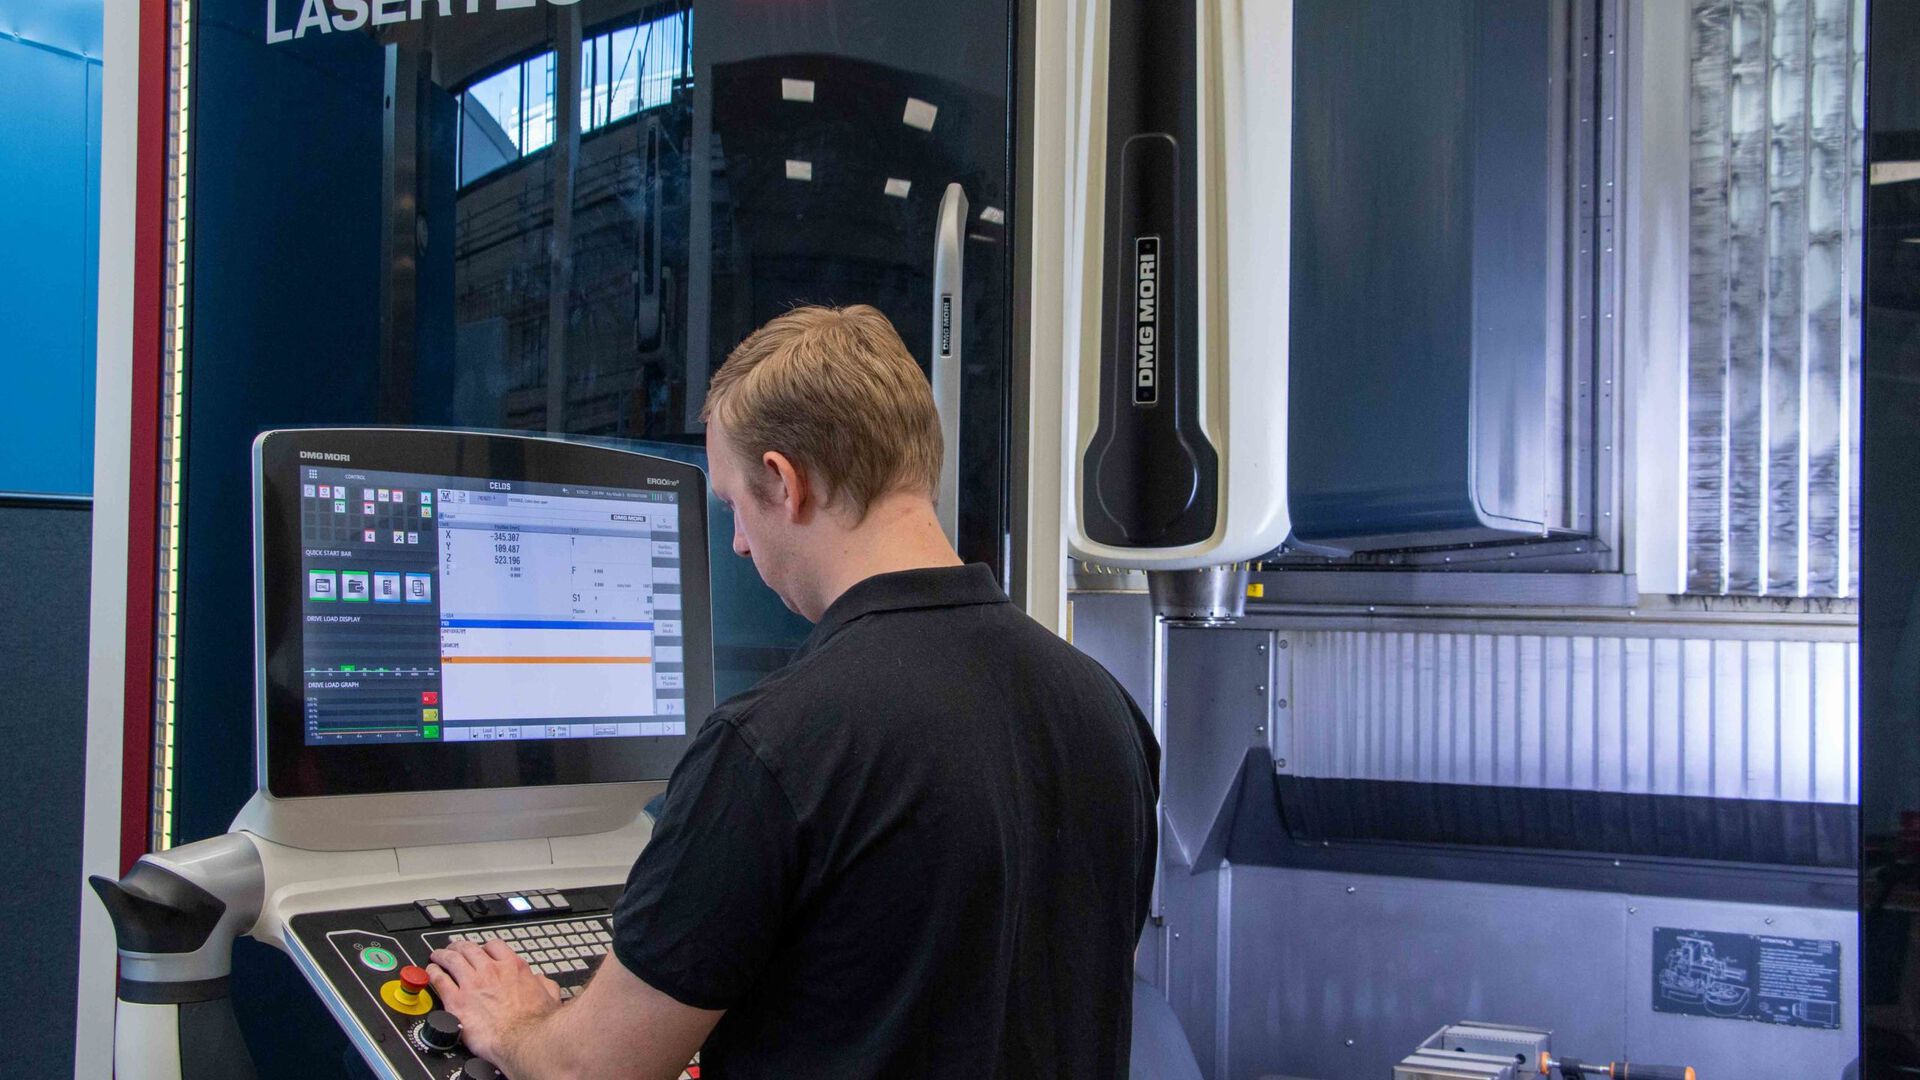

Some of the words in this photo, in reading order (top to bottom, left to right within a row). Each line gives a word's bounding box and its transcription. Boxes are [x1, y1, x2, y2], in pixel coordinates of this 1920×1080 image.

[1139, 254, 1155, 322] MORI
[1138, 326, 1154, 387] DMG
[300, 451, 323, 460] DMG
[324, 453, 350, 462] MORI
[446, 530, 451, 539] X
[446, 541, 451, 550] Y
[305, 549, 322, 557] QUICK
